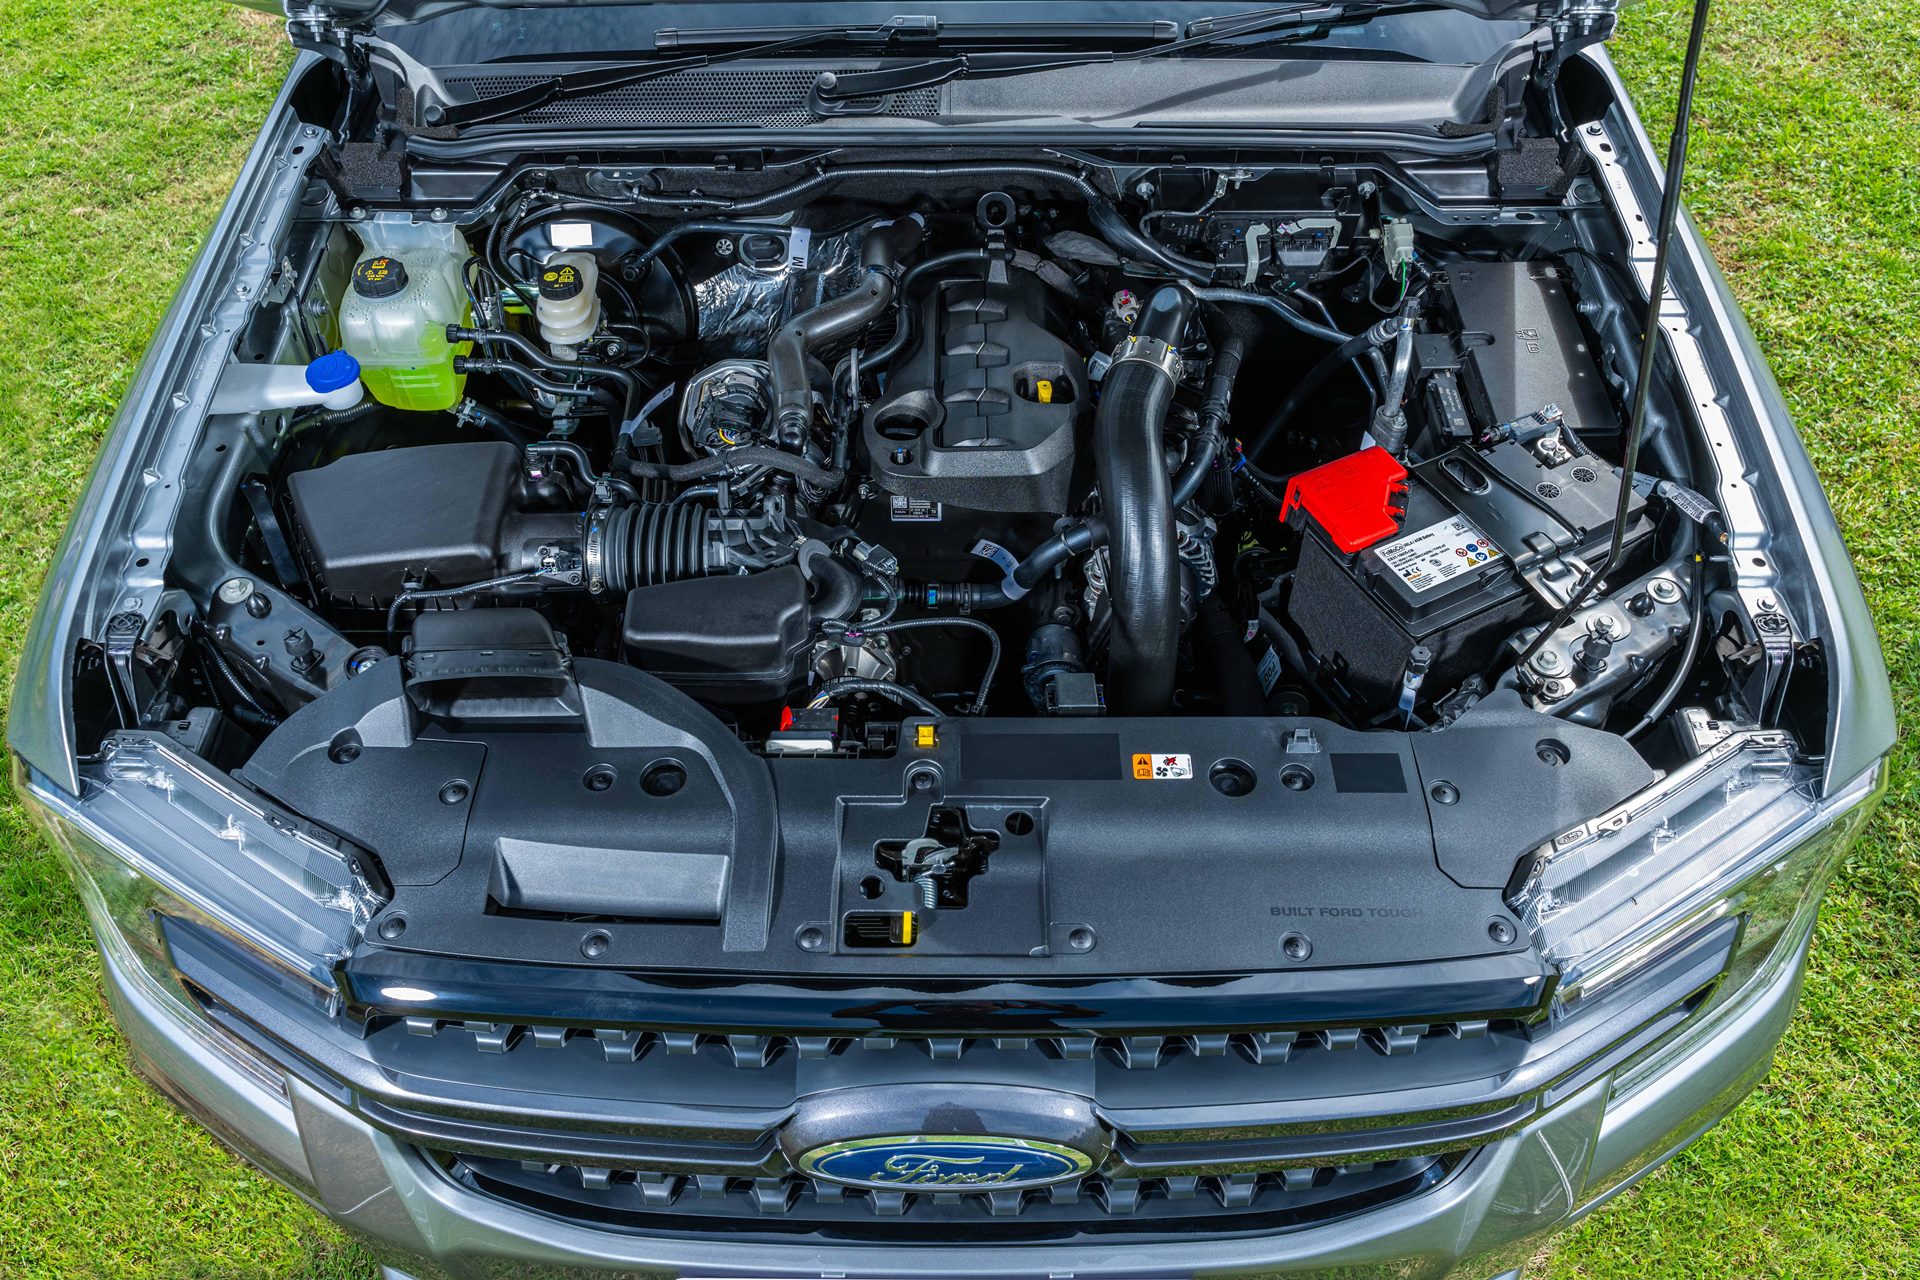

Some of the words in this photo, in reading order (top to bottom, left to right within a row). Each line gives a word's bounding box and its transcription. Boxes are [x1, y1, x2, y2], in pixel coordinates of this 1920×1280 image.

[792, 256, 804, 267] M
[1382, 544, 1404, 556] FoMoCo
[1270, 906, 1314, 917] BUILT
[1319, 908, 1363, 918] FORD
[870, 1154, 1024, 1184] Ford
